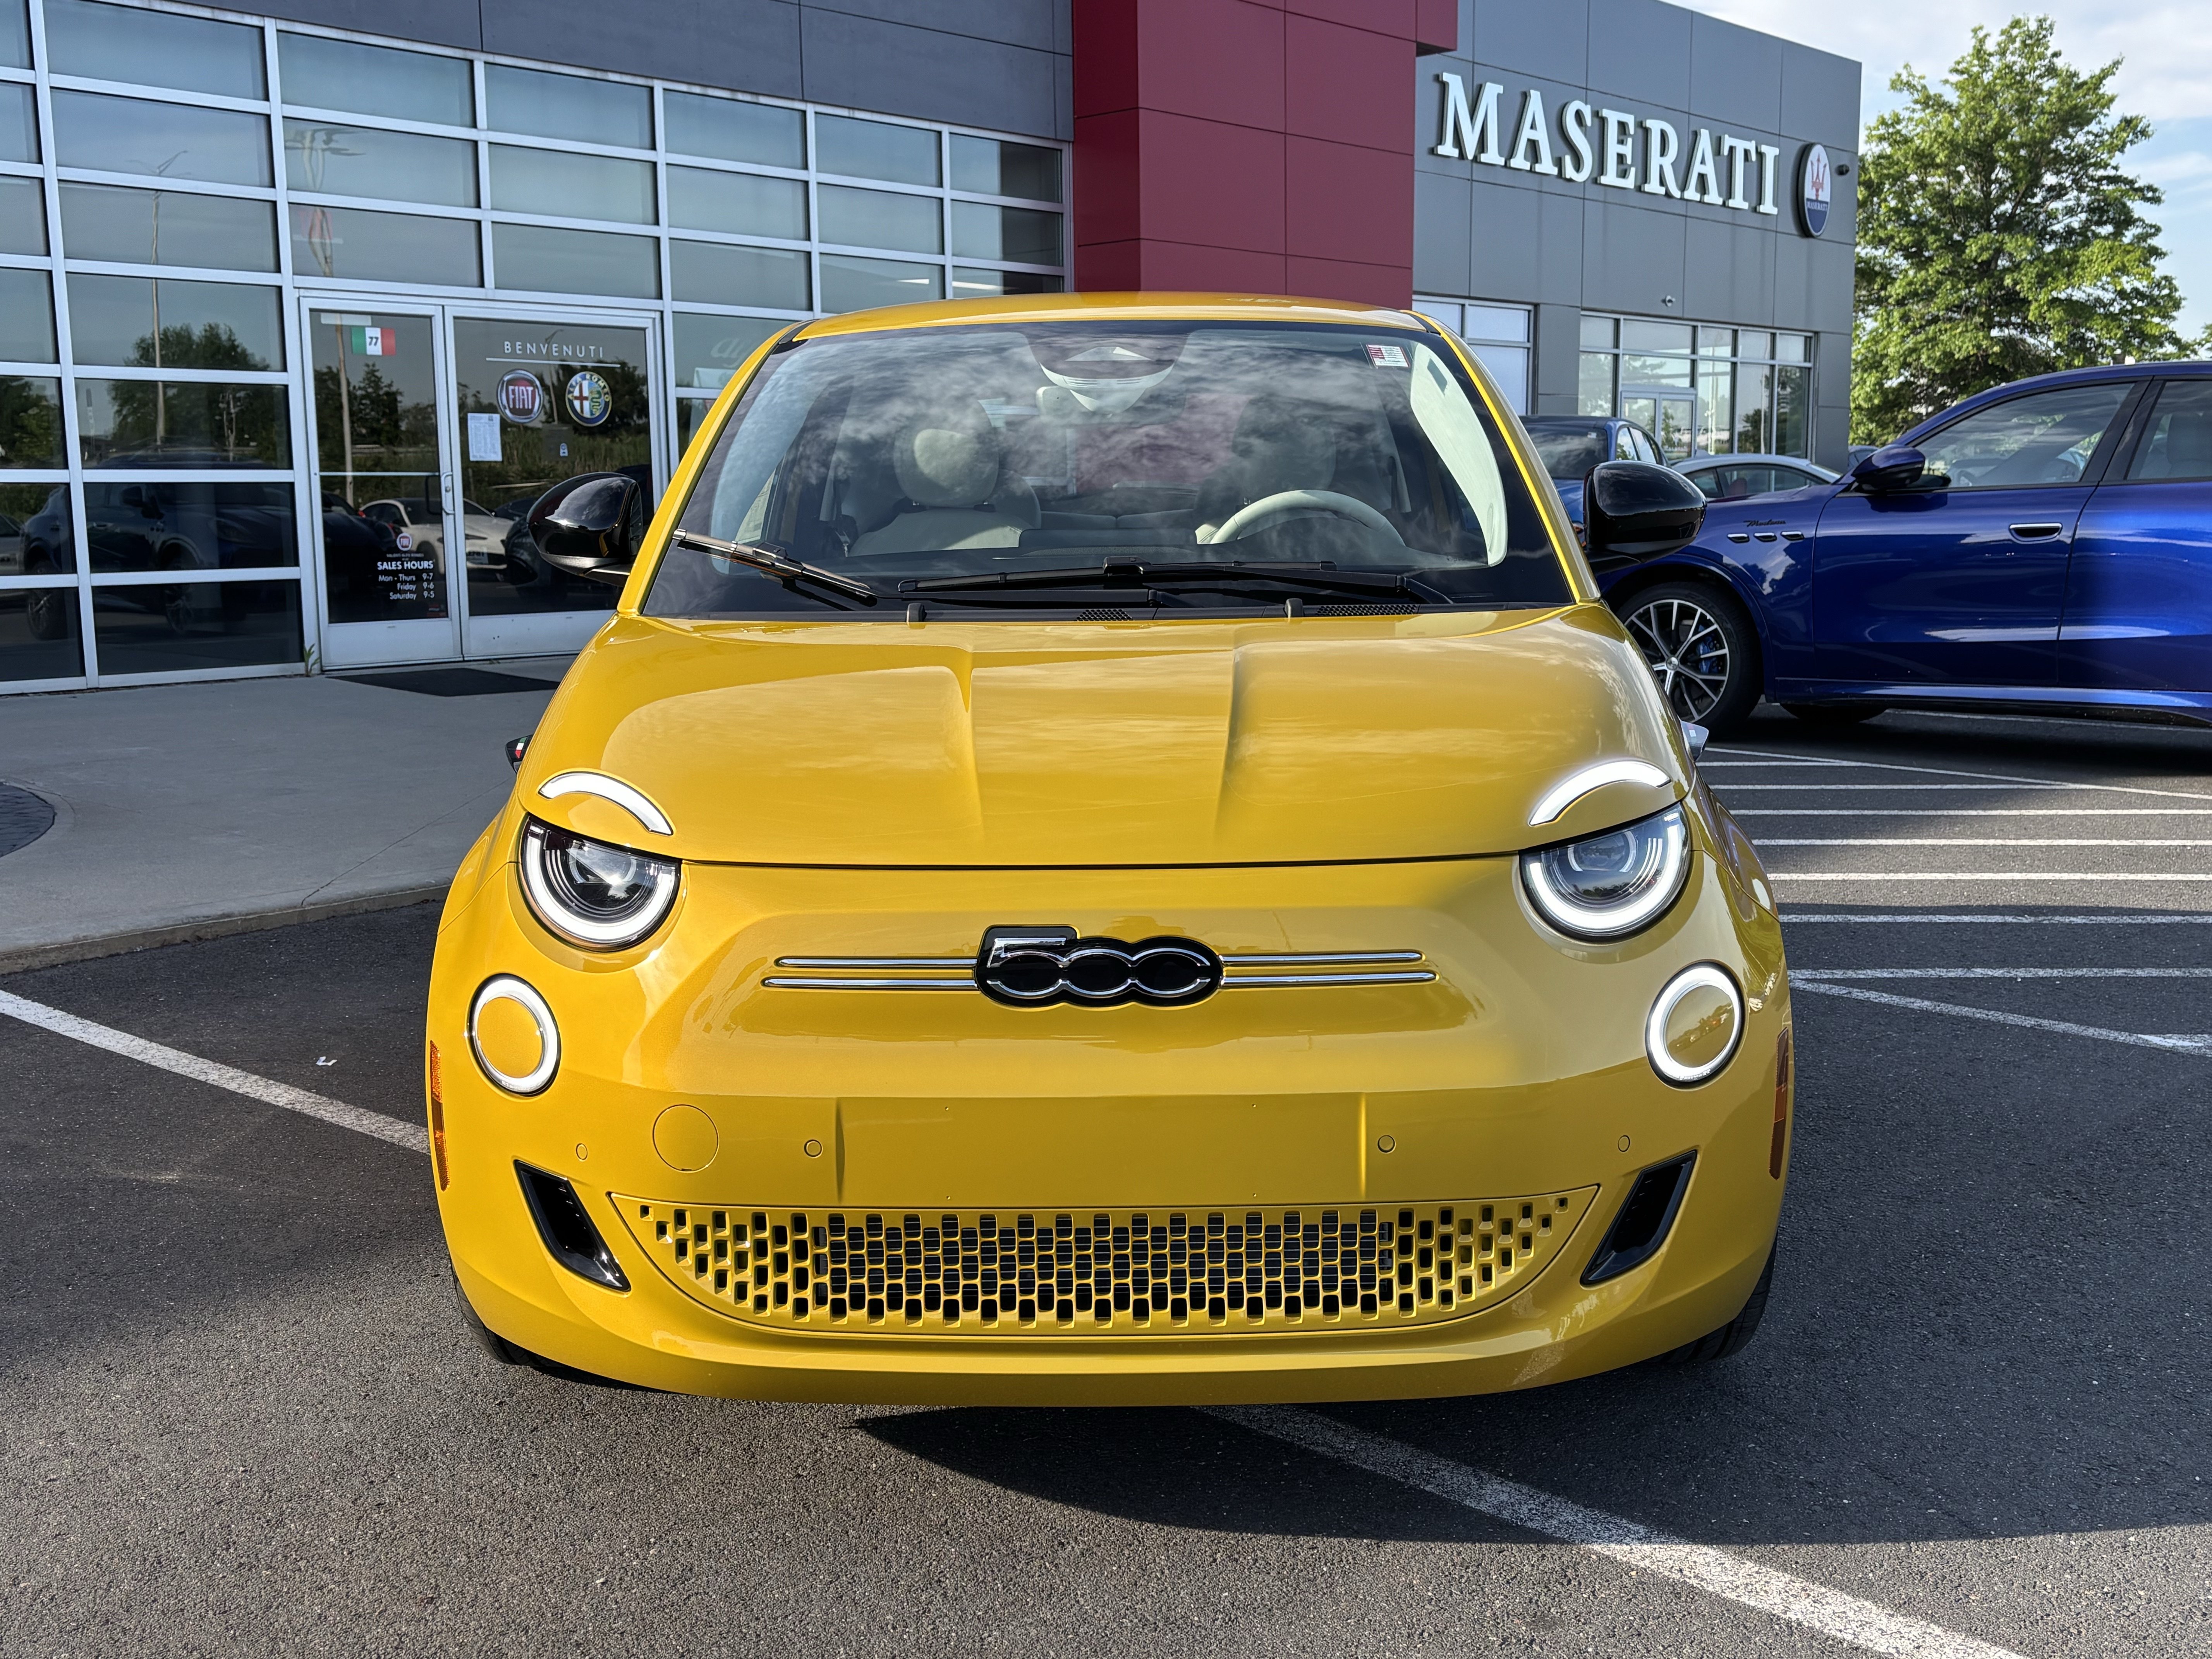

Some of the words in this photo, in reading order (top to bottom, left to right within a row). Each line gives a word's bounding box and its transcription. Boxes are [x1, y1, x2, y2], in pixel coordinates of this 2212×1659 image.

[1434, 72, 1779, 215] MASERATI
[368, 336, 379, 346] 77
[504, 341, 603, 358] BENVENUTI
[508, 385, 534, 409] FIAT
[377, 562, 402, 570] SALES
[404, 561, 434, 569] HOURS
[397, 582, 417, 591] Friday
[390, 592, 417, 600] Saturday
[986, 937, 1211, 996] 500
